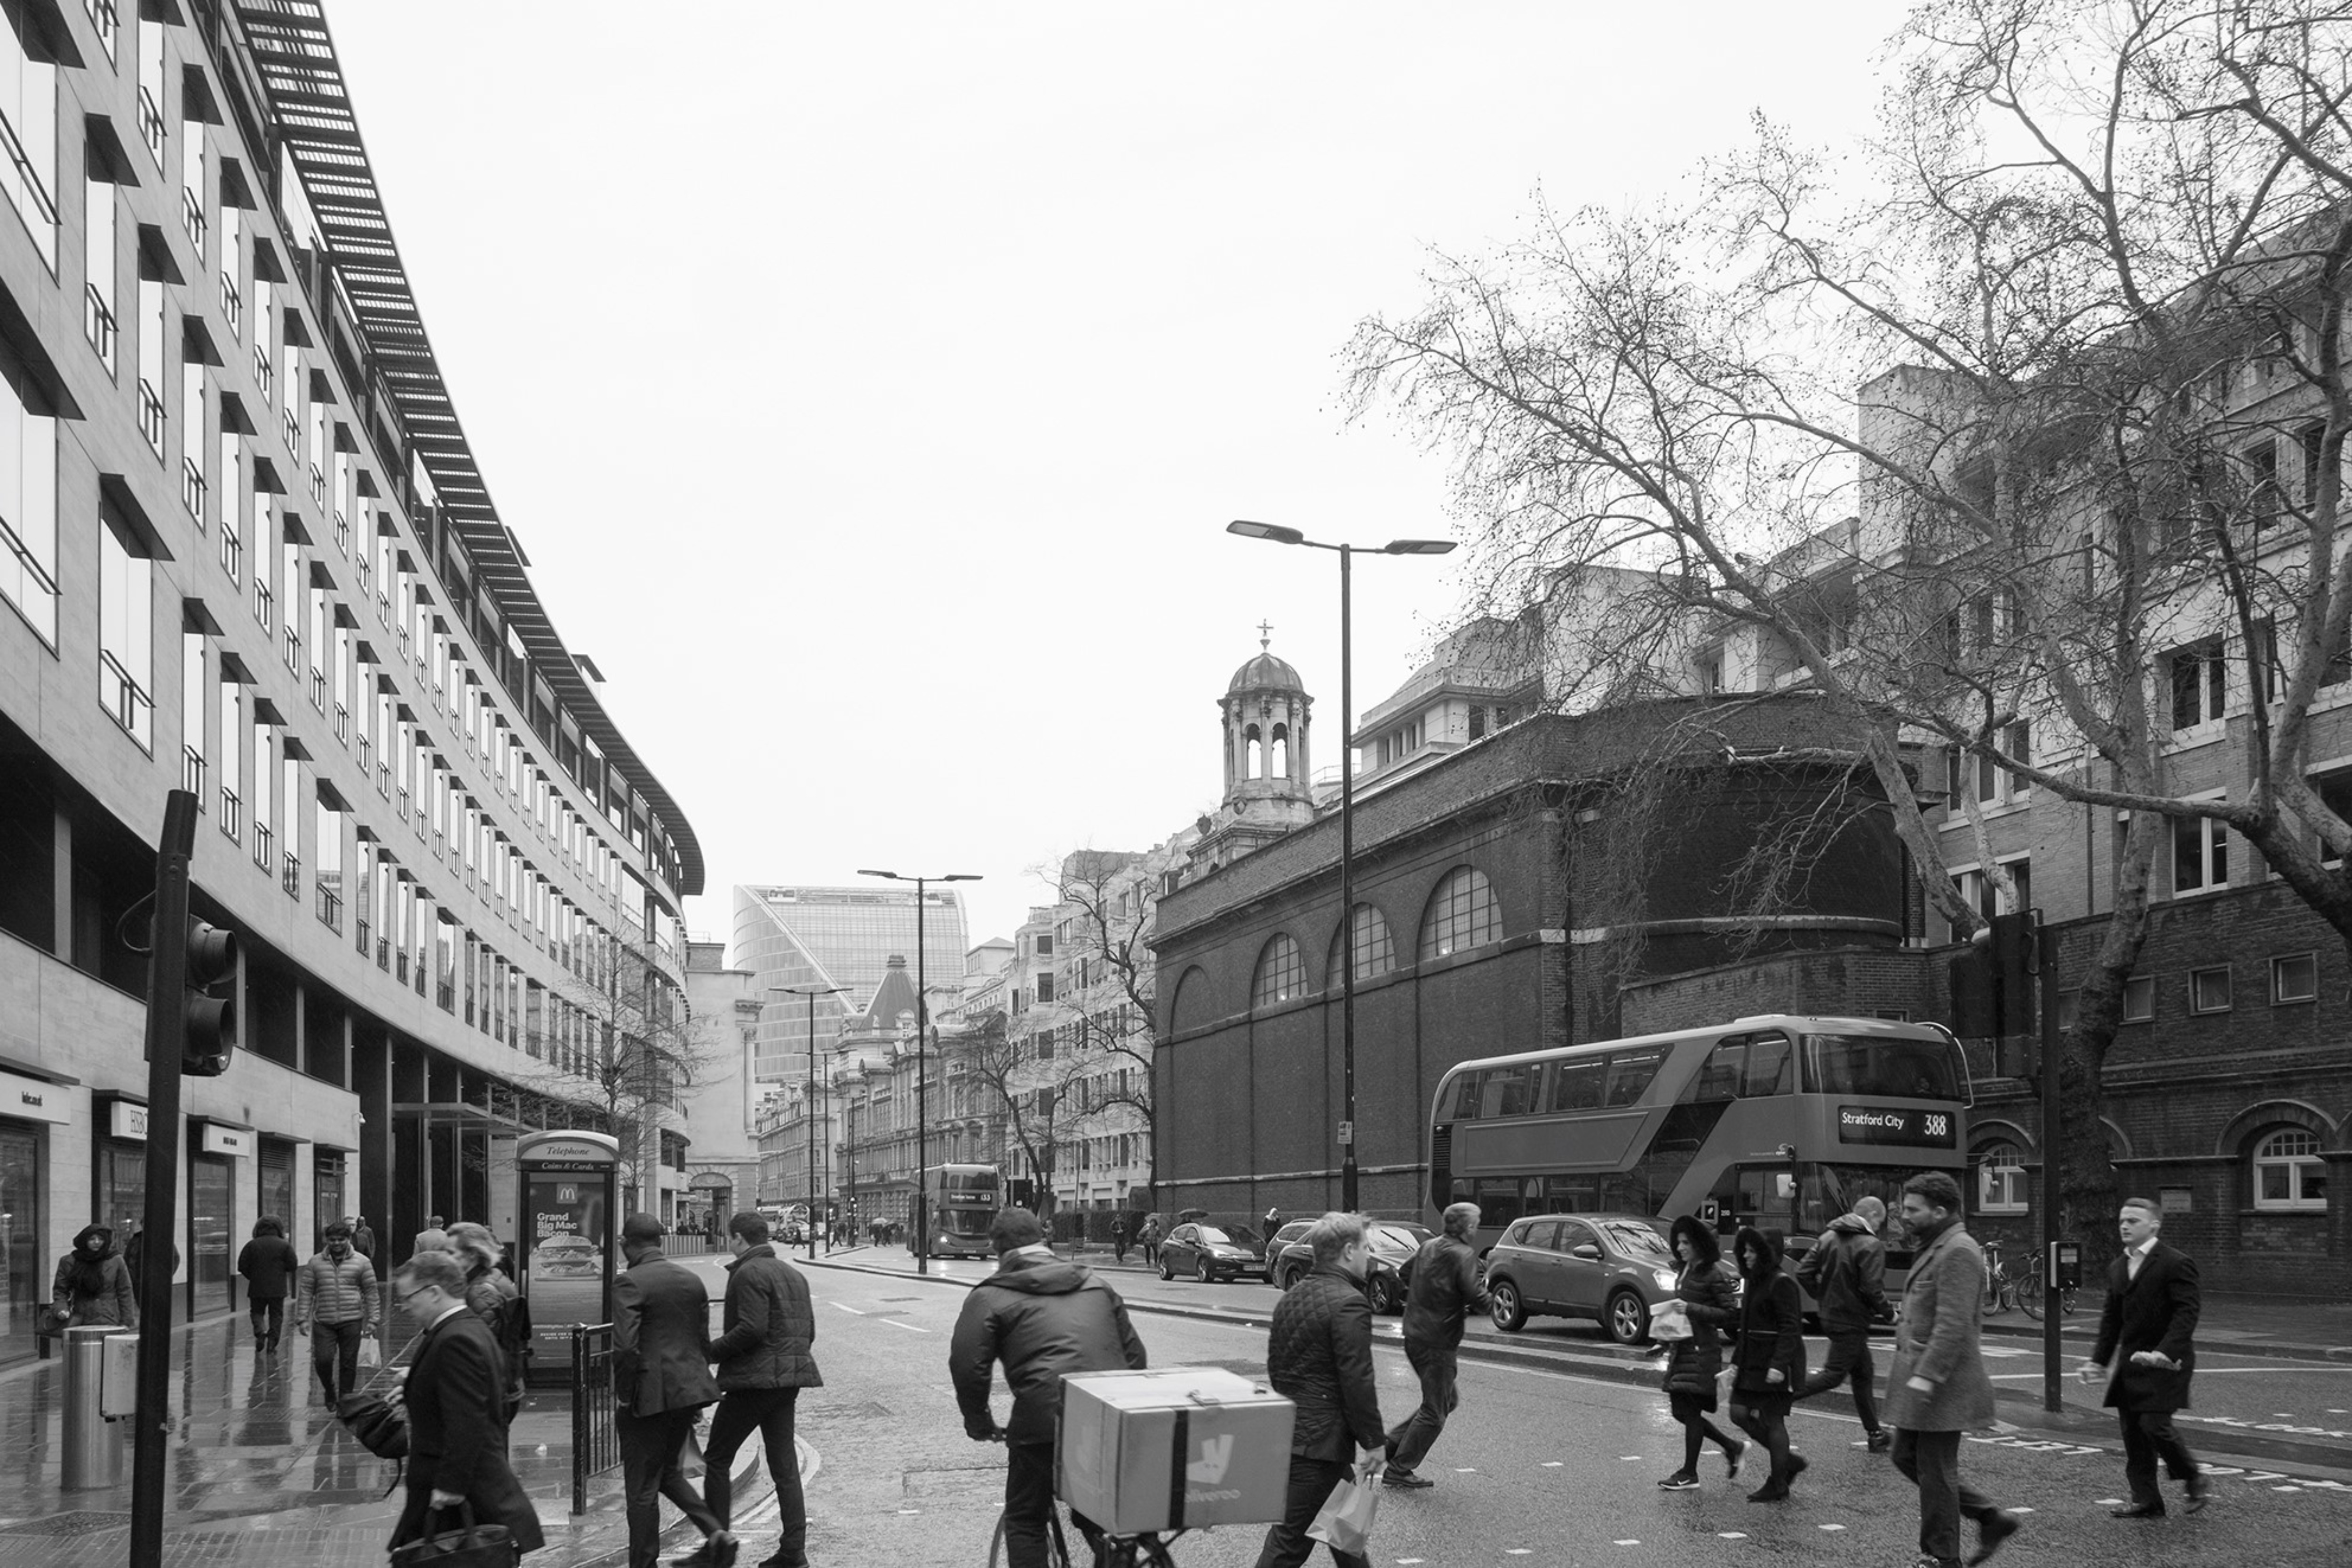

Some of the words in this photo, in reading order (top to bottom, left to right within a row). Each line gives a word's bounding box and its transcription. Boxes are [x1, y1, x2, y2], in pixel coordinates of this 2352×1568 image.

[1842, 1112, 1883, 1126] Stratford
[1885, 1115, 1904, 1130] City
[1924, 1114, 1946, 1136] 388
[547, 1146, 590, 1156] Telephone
[537, 1212, 569, 1221] Grand
[537, 1221, 554, 1231] Big
